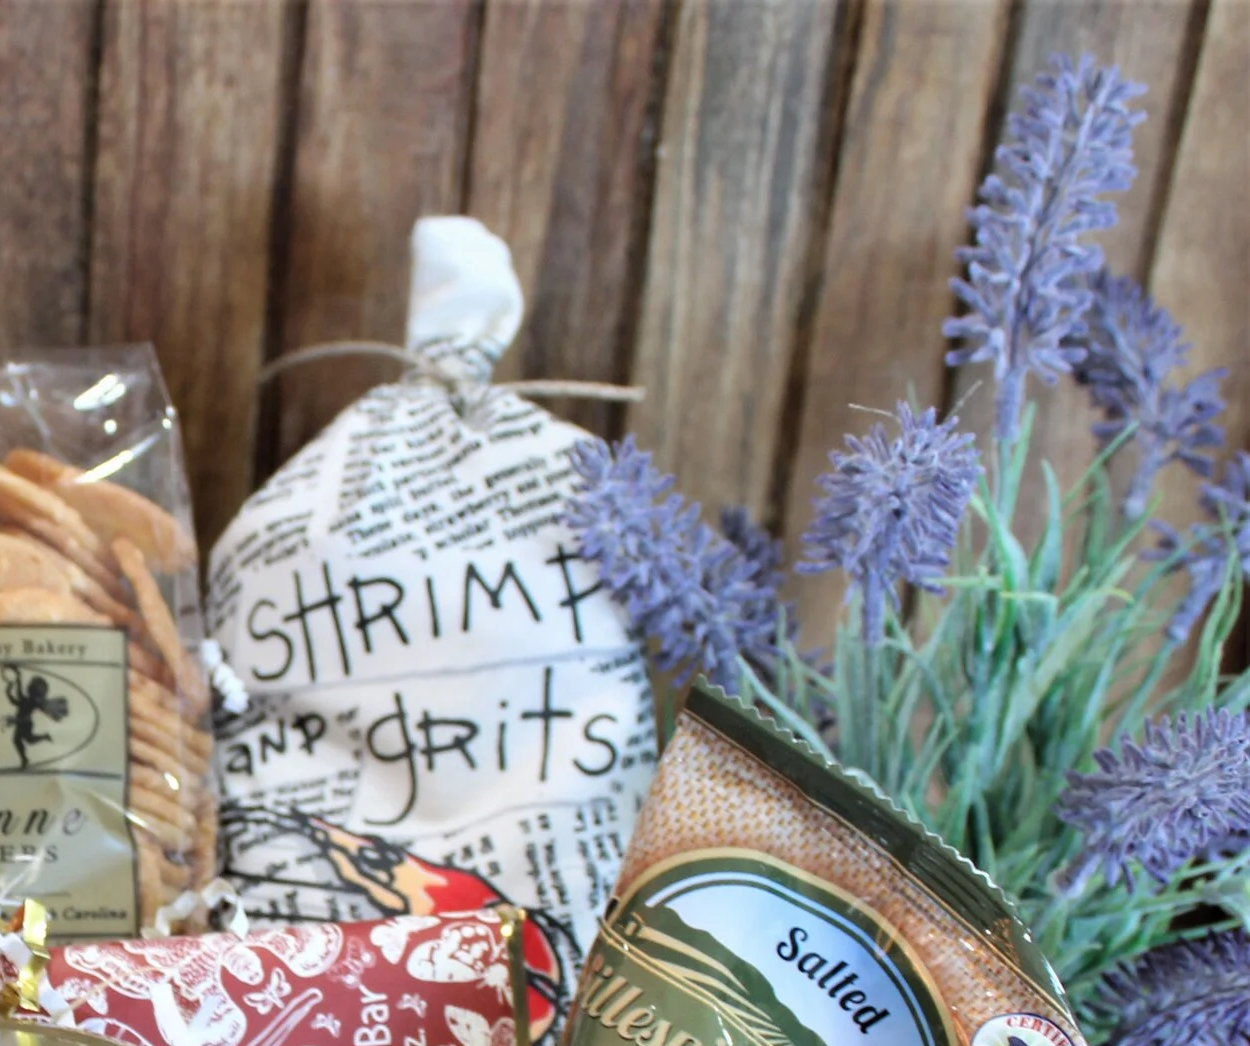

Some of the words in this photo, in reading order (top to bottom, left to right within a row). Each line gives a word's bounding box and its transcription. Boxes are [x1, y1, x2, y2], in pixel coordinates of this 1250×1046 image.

[23, 639, 88, 658] Bakery
[247, 544, 607, 684] SHRIMP
[775, 926, 890, 1036] Salted
